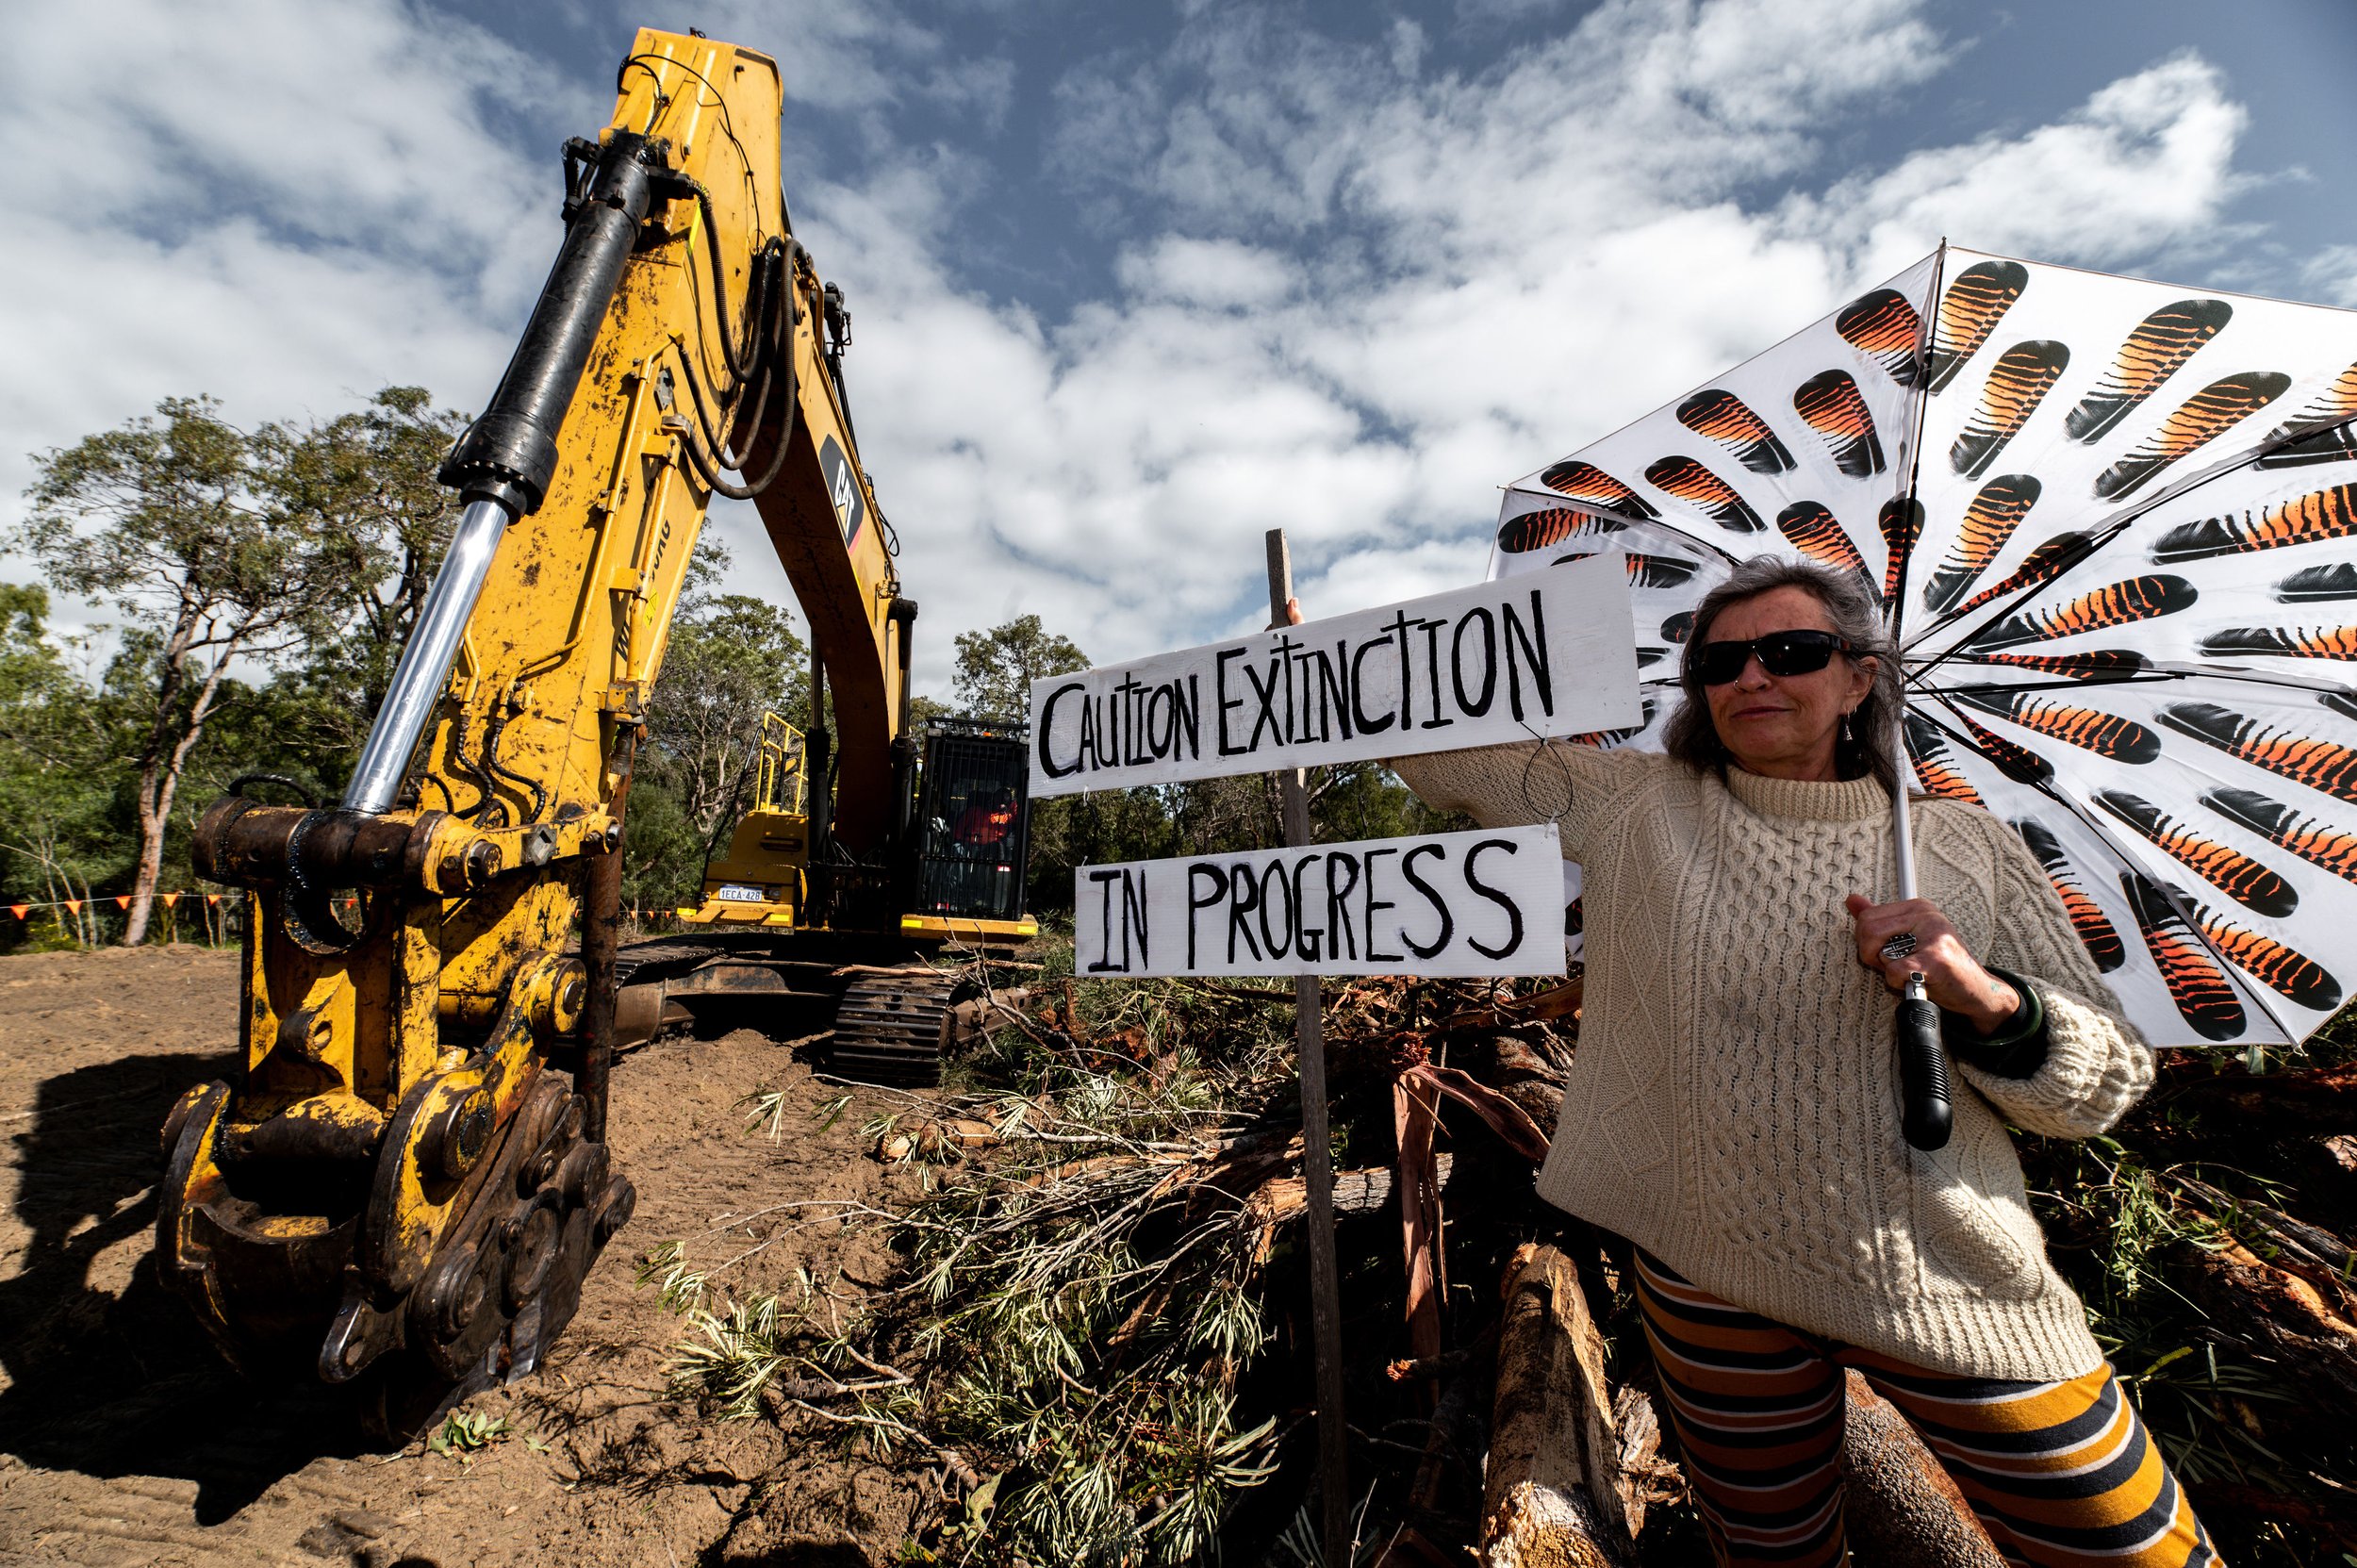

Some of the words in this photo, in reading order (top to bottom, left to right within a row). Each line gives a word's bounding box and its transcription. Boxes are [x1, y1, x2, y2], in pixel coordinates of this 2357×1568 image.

[833, 458, 855, 538] CAT
[721, 890, 761, 900] 1ECA-428
[1088, 868, 1148, 973] IN
[1188, 839, 1524, 970] PROGRESS
